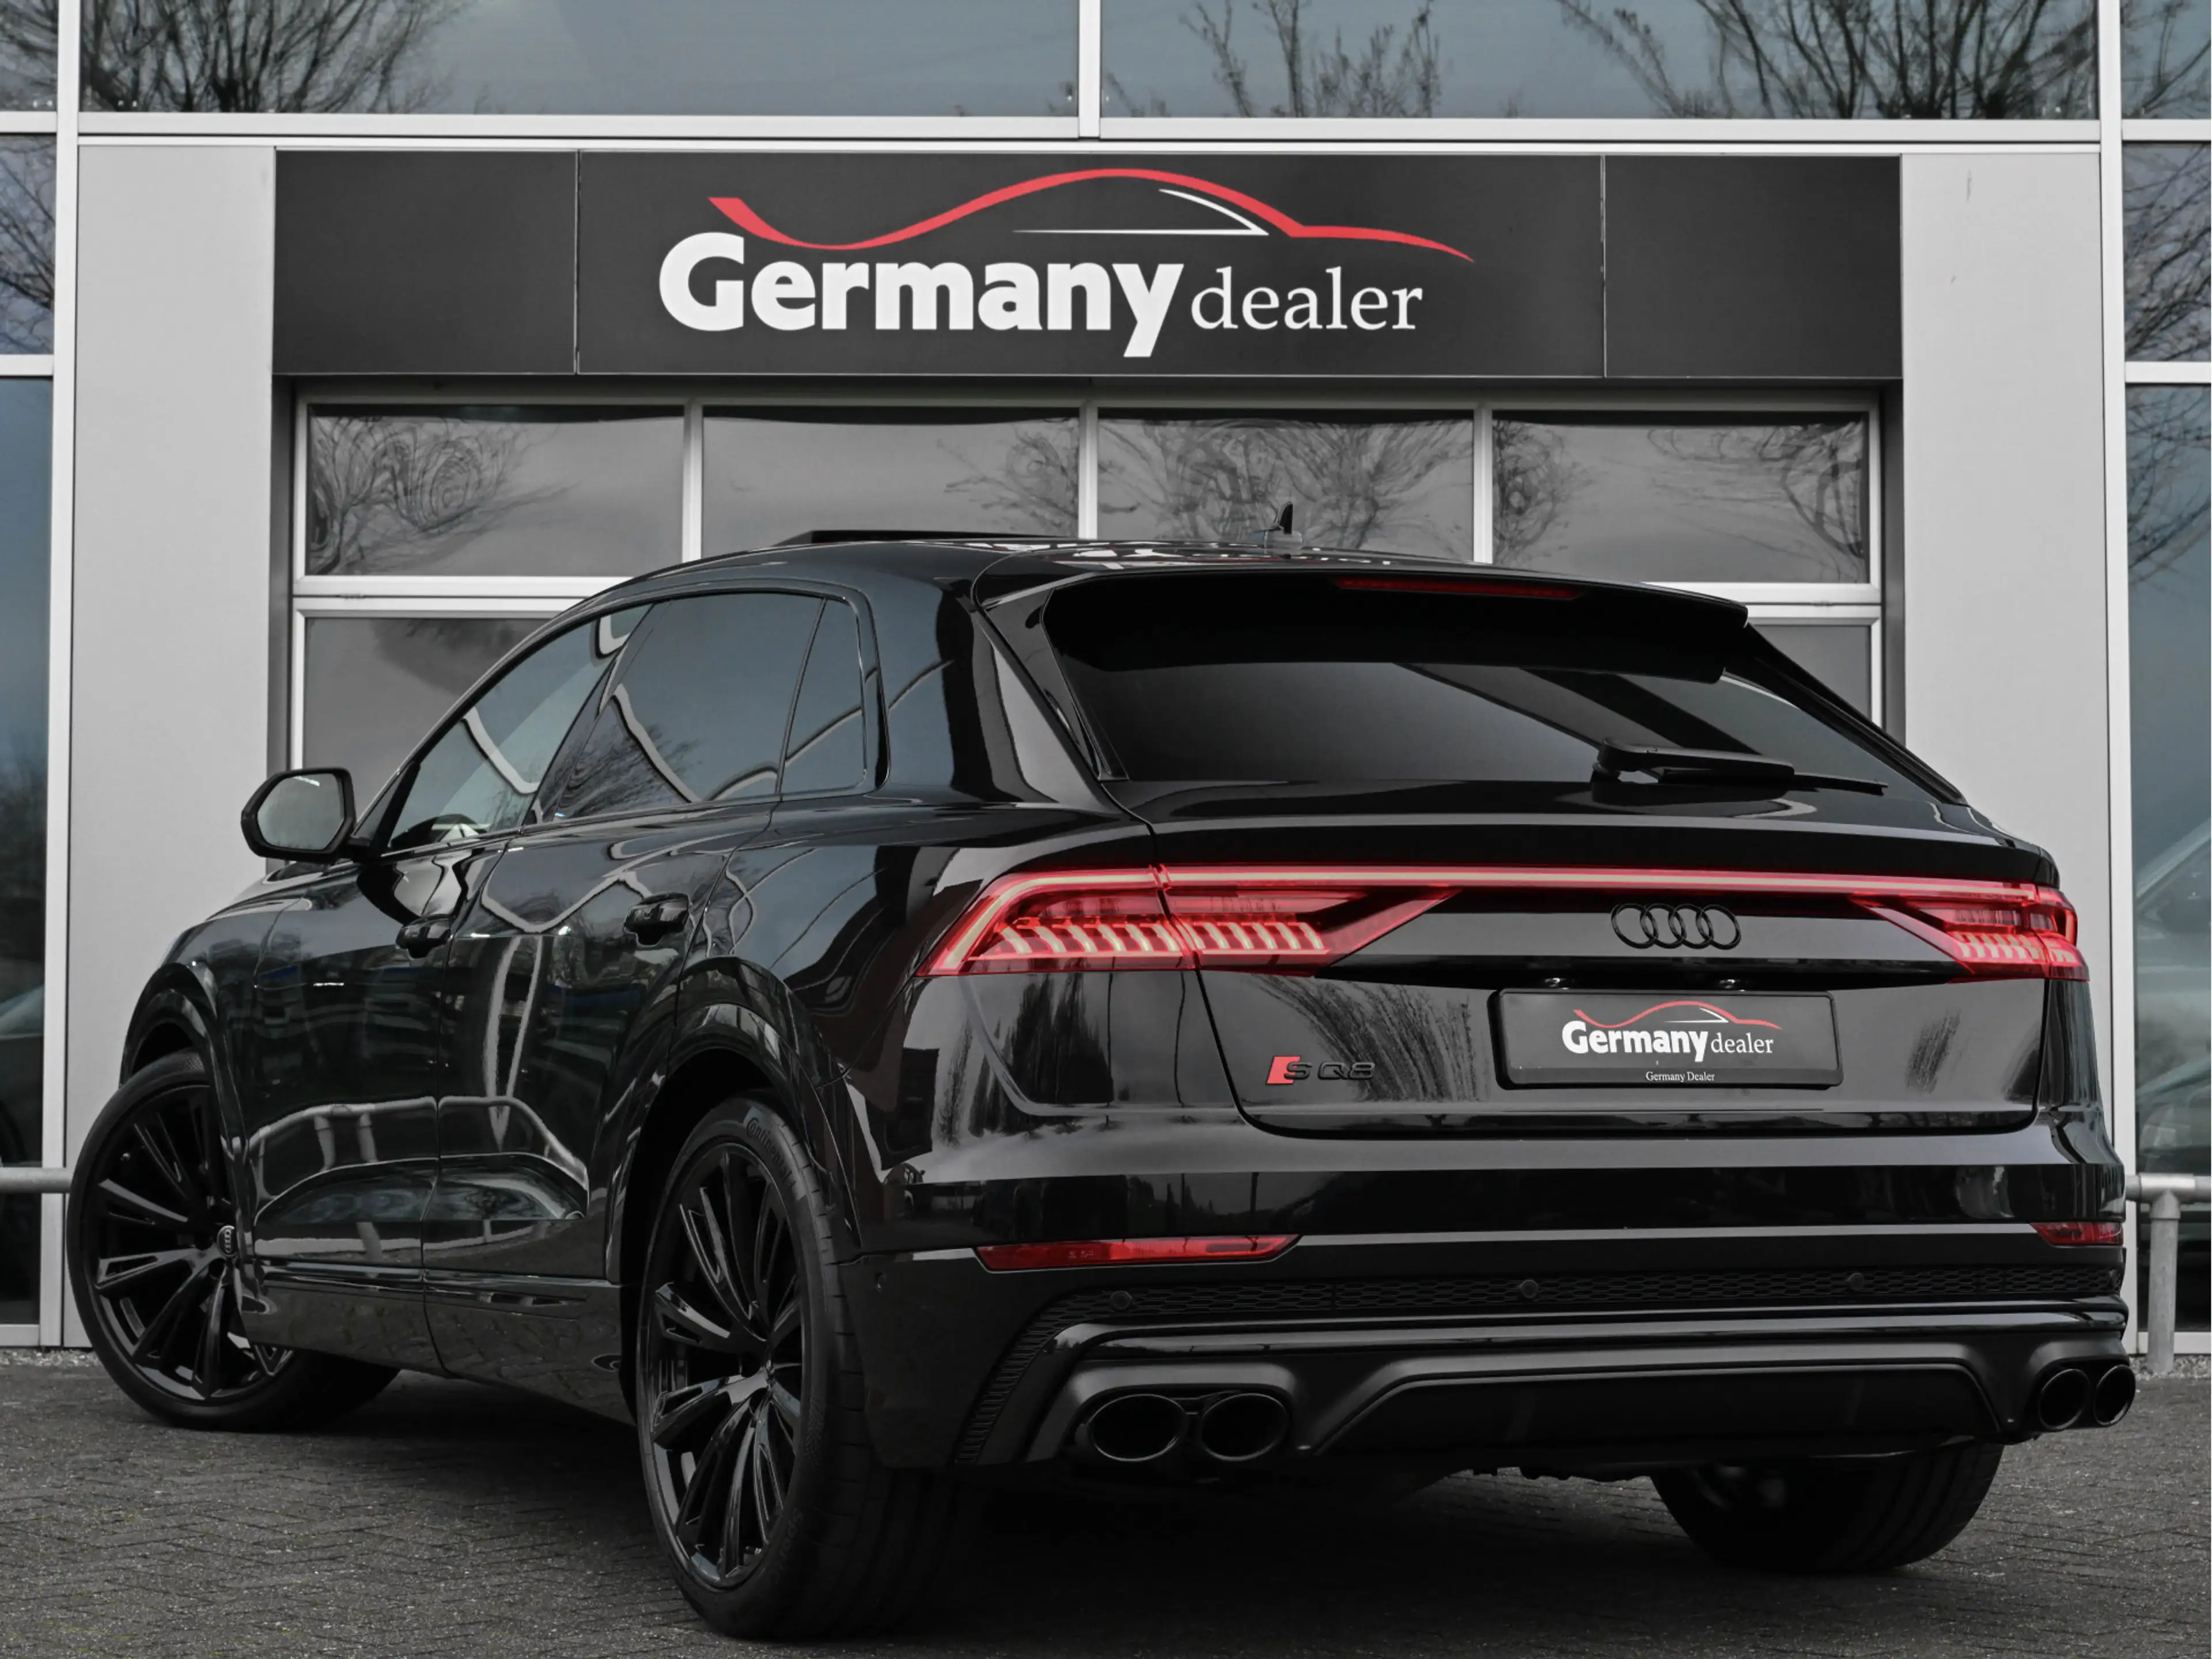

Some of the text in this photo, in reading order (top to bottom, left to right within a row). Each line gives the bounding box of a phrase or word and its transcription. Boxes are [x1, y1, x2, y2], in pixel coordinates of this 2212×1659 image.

[659, 232, 1423, 357] Germany dealer
[1562, 1020, 1774, 1062] Germany dealer
[1646, 1071, 1715, 1083] Germany Dealer
[747, 1118, 792, 1184] Continental
